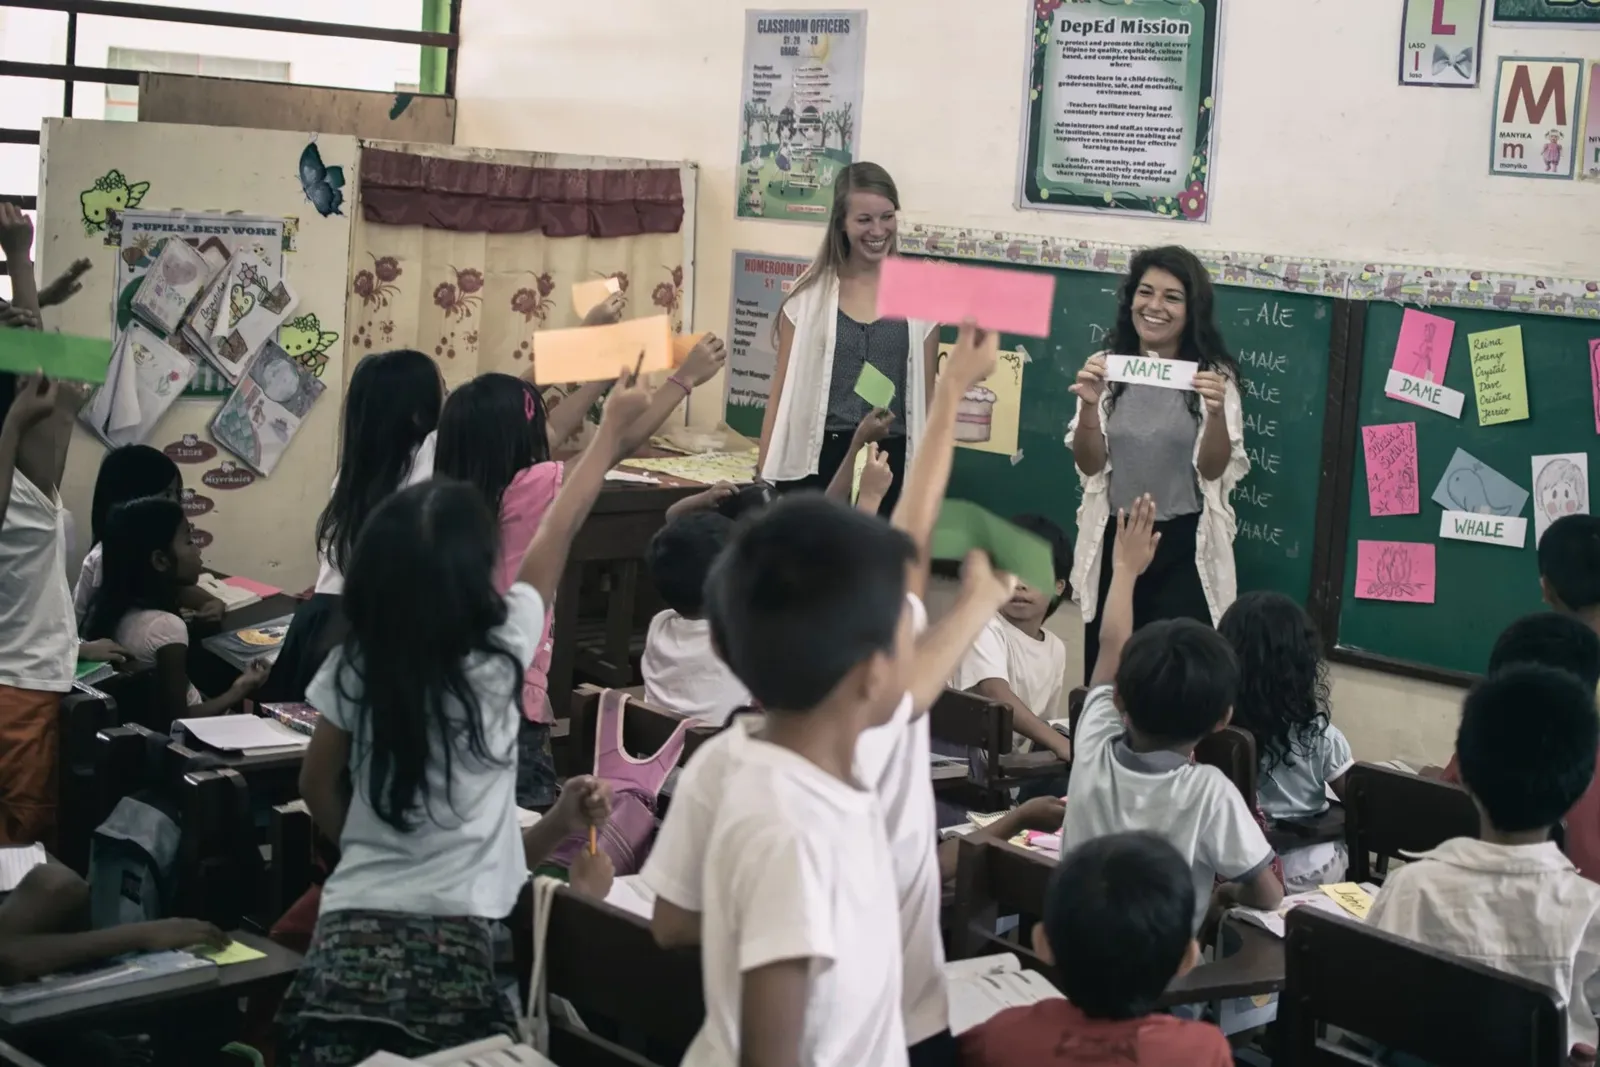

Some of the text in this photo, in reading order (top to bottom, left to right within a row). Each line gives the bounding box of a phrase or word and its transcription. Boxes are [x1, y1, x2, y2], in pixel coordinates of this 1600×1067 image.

[757, 19, 850, 33] CLASSROOM OFFICERS
[1060, 18, 1190, 37] DepEd Mission
[780, 46, 800, 56] GRADE:
[1502, 65, 1567, 126] M
[1499, 131, 1533, 140] MANYIKA
[1502, 142, 1524, 159] m
[1499, 162, 1528, 170] manyika
[132, 222, 278, 237] PUPILS' BEST WORK
[744, 259, 794, 276] HOMEROOM
[746, 309, 769, 319] President
[735, 318, 758, 329] Secretary
[1474, 337, 1504, 350] Reina
[1238, 349, 1286, 373] MALE
[732, 368, 770, 380] Project Manager
[1122, 359, 1172, 380] NAME
[1400, 377, 1442, 405] DAME
[1244, 414, 1276, 437] ALE
[1455, 518, 1504, 538] WHALE
